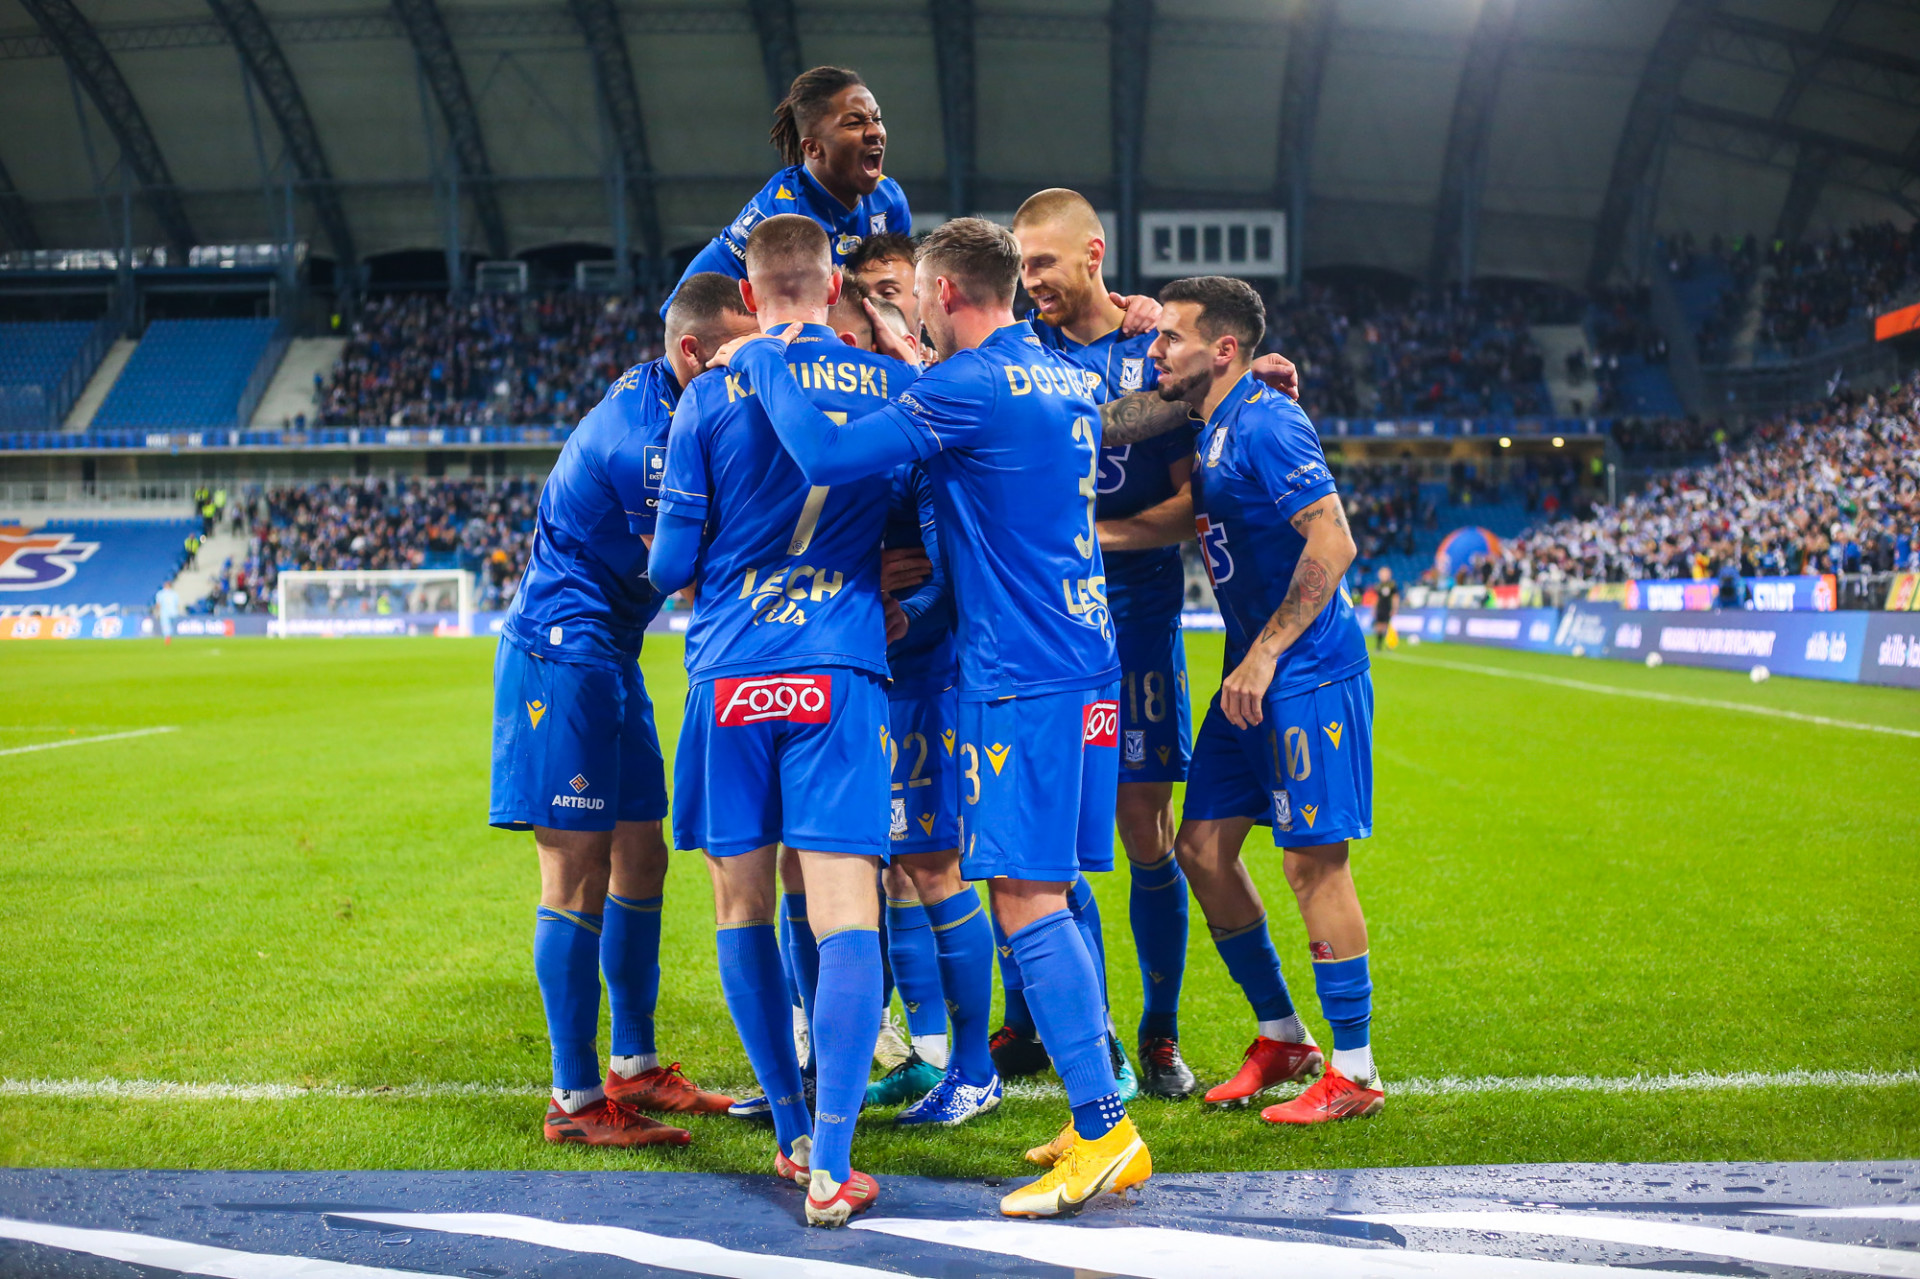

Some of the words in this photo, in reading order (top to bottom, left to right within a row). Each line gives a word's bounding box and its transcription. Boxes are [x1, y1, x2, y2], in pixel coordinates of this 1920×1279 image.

[724, 355, 888, 403] KIŃSKI
[1072, 416, 1097, 560] 3
[738, 565, 844, 602] LECH
[751, 593, 807, 626] Pils
[1121, 670, 1165, 723] 18
[960, 742, 981, 805] 3
[1268, 726, 1311, 782] 10
[552, 795, 605, 810] ARTBUD
